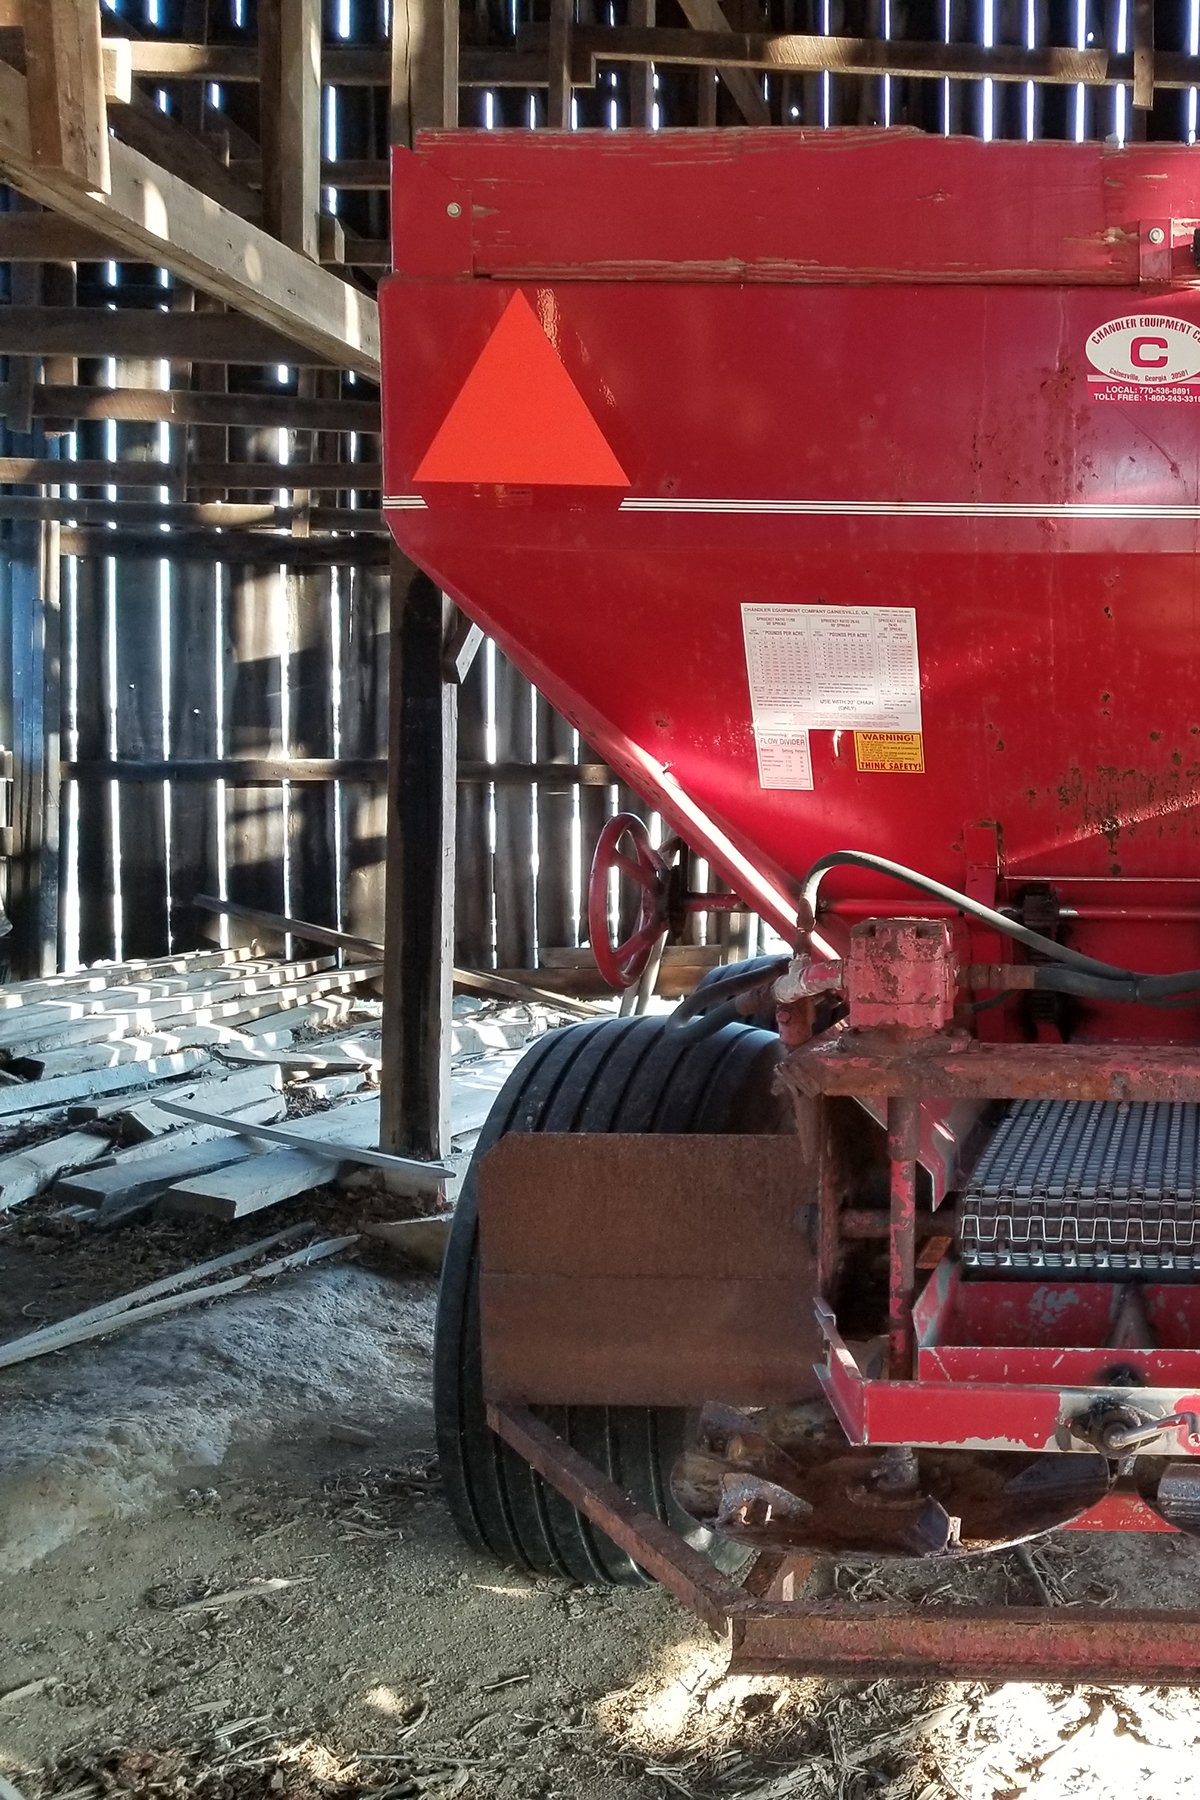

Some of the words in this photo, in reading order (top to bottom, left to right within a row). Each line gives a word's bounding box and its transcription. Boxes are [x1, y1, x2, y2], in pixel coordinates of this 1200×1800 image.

[1091, 318, 1137, 345] CHANDLER
[1139, 317, 1192, 335] EQUIPMENT
[1130, 336, 1169, 368] C
[1144, 375, 1168, 383] Georgia
[1106, 386, 1137, 394] LOCAL:
[1094, 393, 1115, 401] TOLL
[862, 733, 914, 742] WARNING!
[889, 762, 921, 771] SAFETY!
